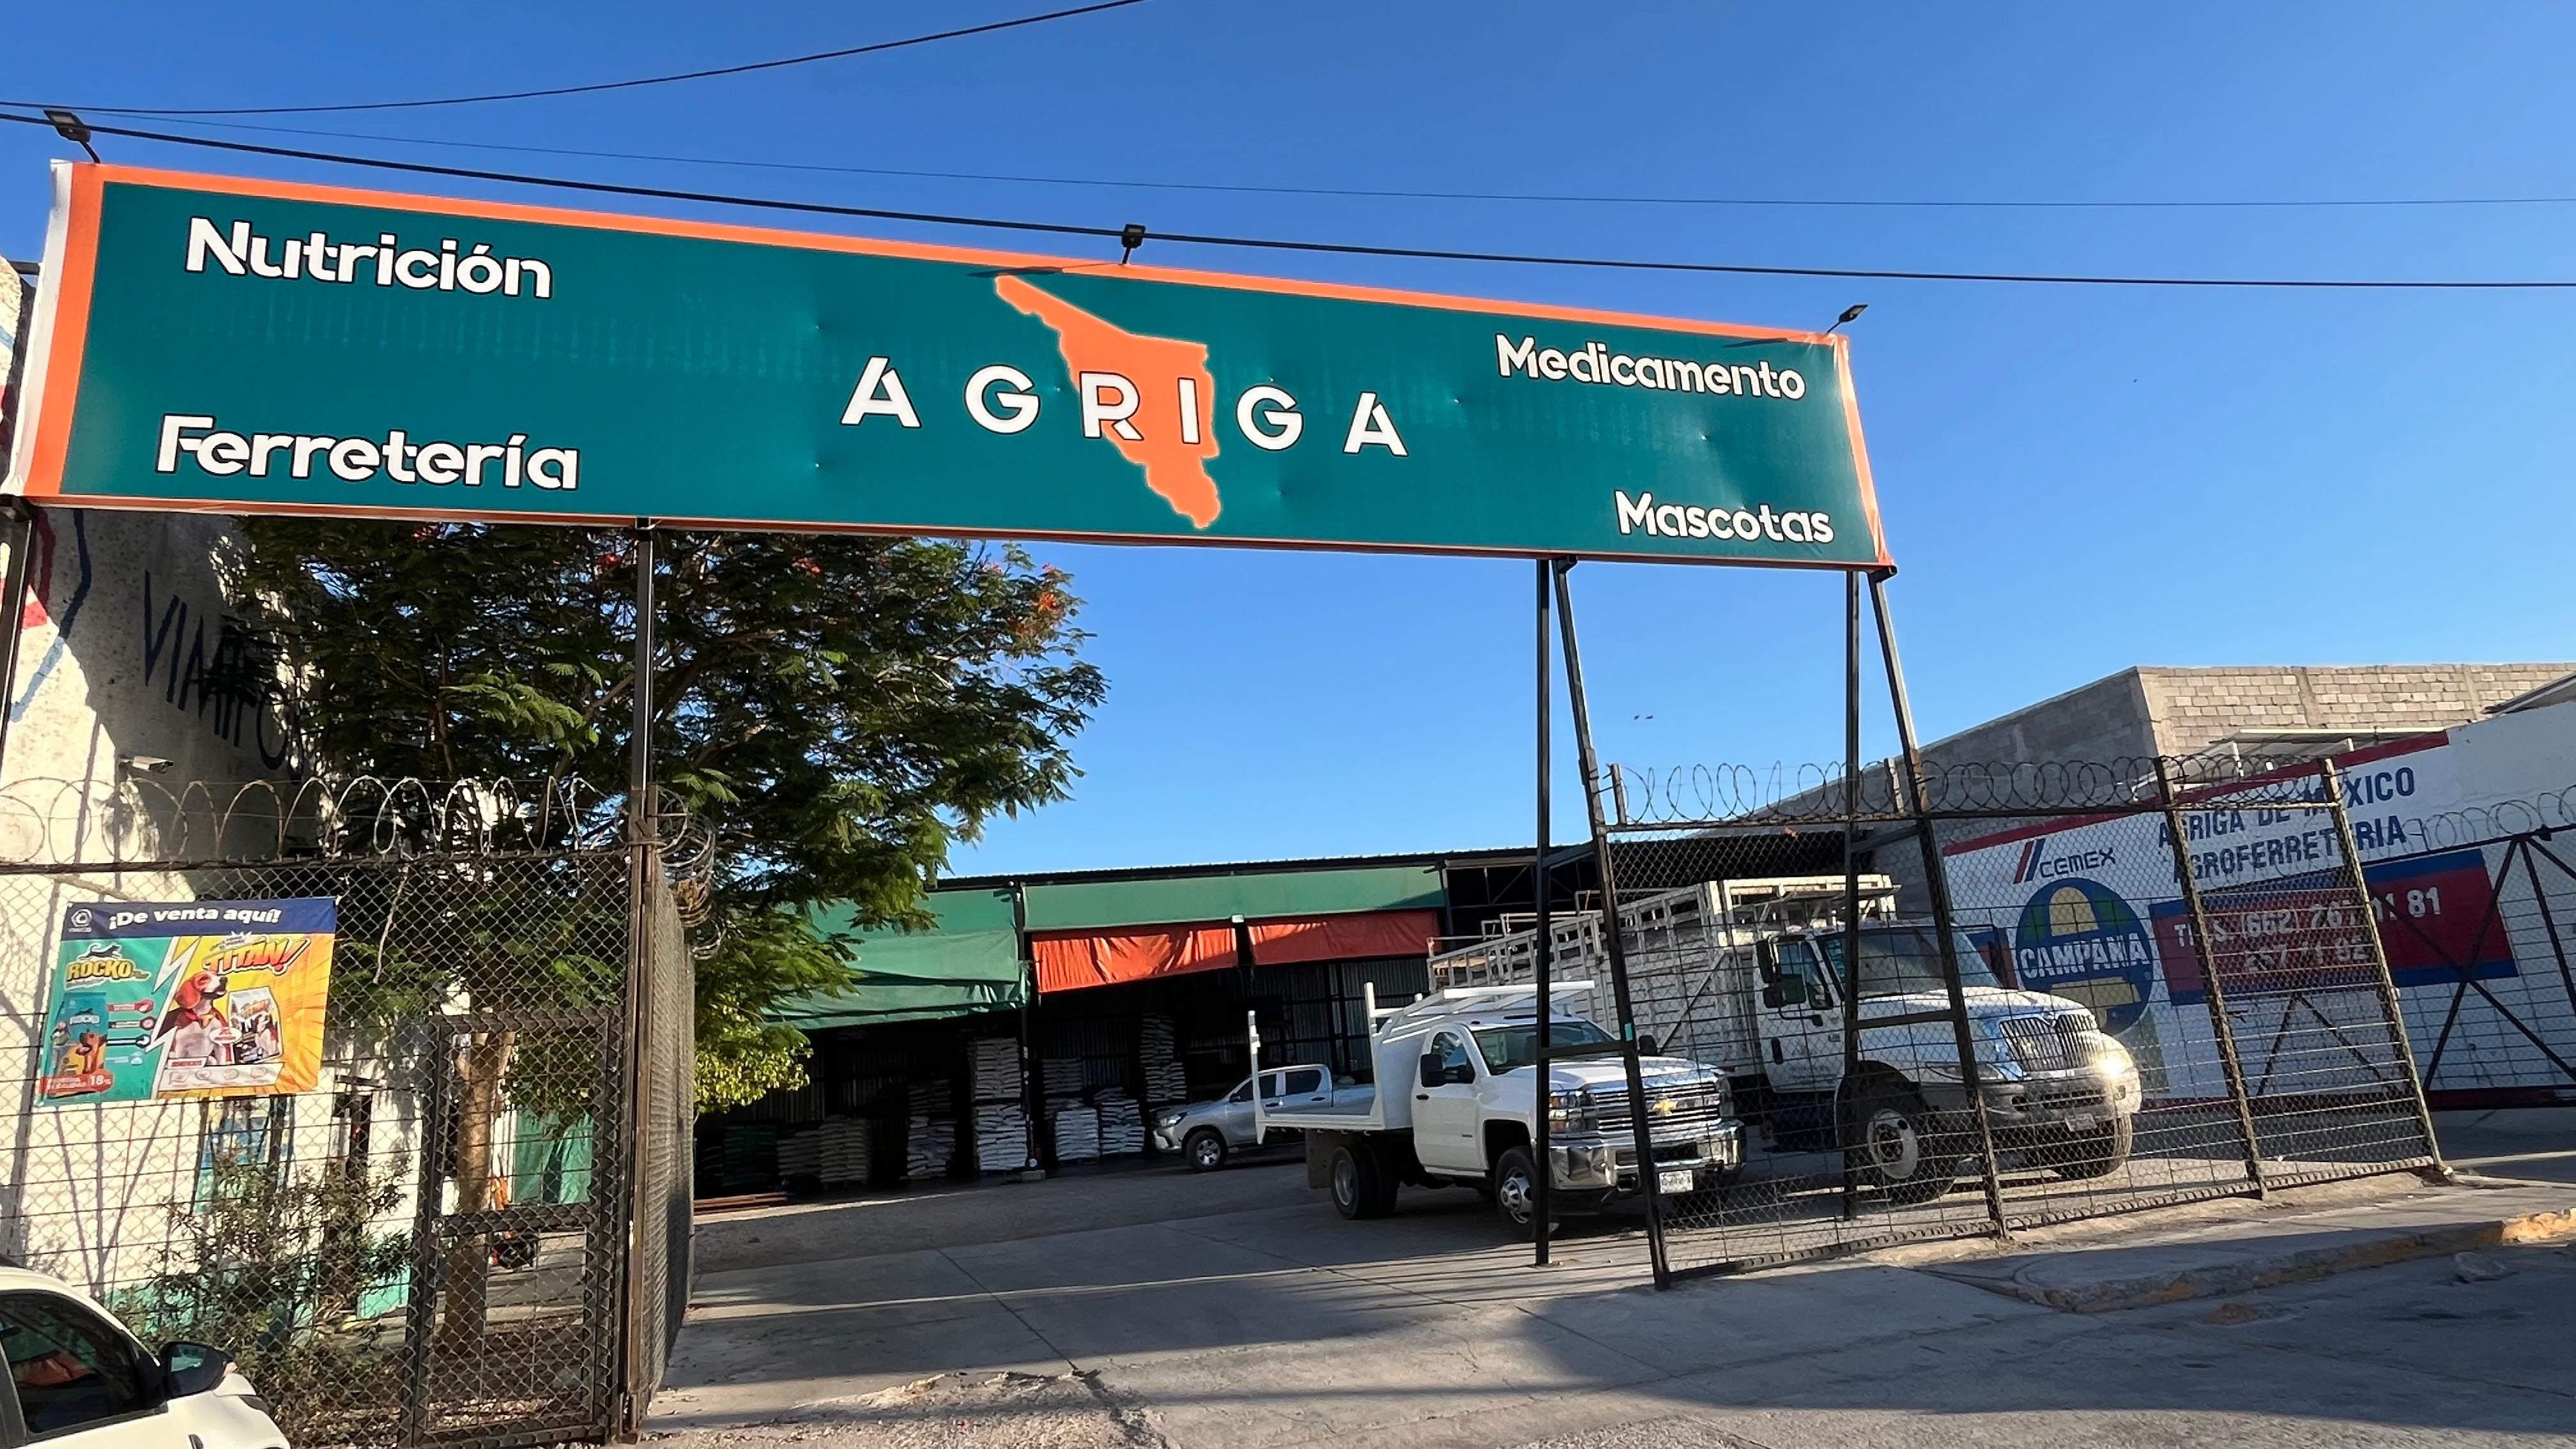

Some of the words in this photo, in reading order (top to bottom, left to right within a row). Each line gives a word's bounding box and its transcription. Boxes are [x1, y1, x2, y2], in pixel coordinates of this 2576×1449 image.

[185, 216, 554, 300] Nutrición
[1494, 332, 1806, 400] Medicamento
[839, 356, 1409, 457] AGRIGA
[155, 413, 581, 491] Ferretería
[1614, 490, 1835, 544] Mascotas
[2159, 808, 2245, 848] ARIGA
[2304, 766, 2415, 817] MXICO
[2039, 847, 2116, 878] CEMEX
[2174, 815, 2407, 884] GROFERRETRIA
[109, 912, 148, 930] ¡De
[154, 907, 219, 921] venta
[224, 908, 282, 924] aquí!
[2407, 886, 2442, 918] 81
[66, 960, 134, 981] ROCKO
[2020, 933, 2151, 979] CAMPANA
